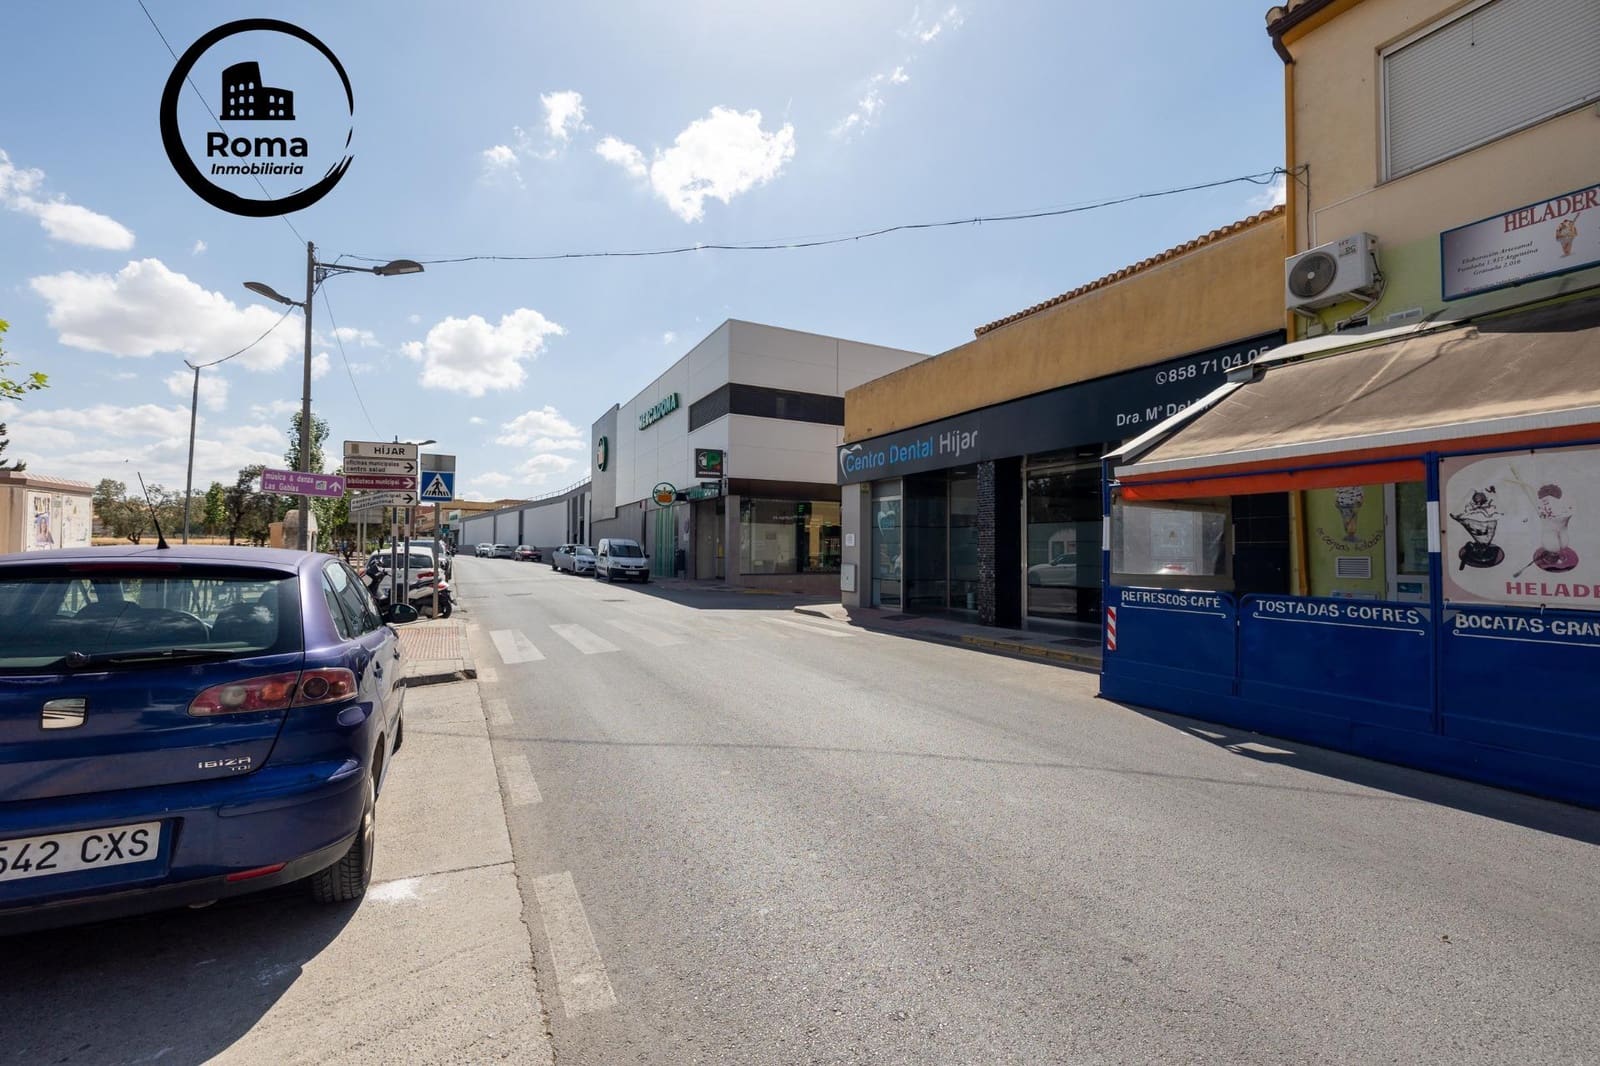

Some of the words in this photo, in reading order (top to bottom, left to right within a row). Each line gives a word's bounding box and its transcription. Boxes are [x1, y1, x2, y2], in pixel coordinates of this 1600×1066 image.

[1503, 188, 1600, 233] HELADER
[1168, 364, 1197, 383] 858
[1116, 411, 1143, 427] Dra.
[373, 445, 406, 456] HÍJAR
[846, 450, 885, 472] Centro
[889, 436, 934, 463] Dental
[939, 430, 978, 457] Híjar
[264, 481, 276, 490] Las
[198, 757, 252, 769] IBIZA
[80, 829, 150, 864] CXS
